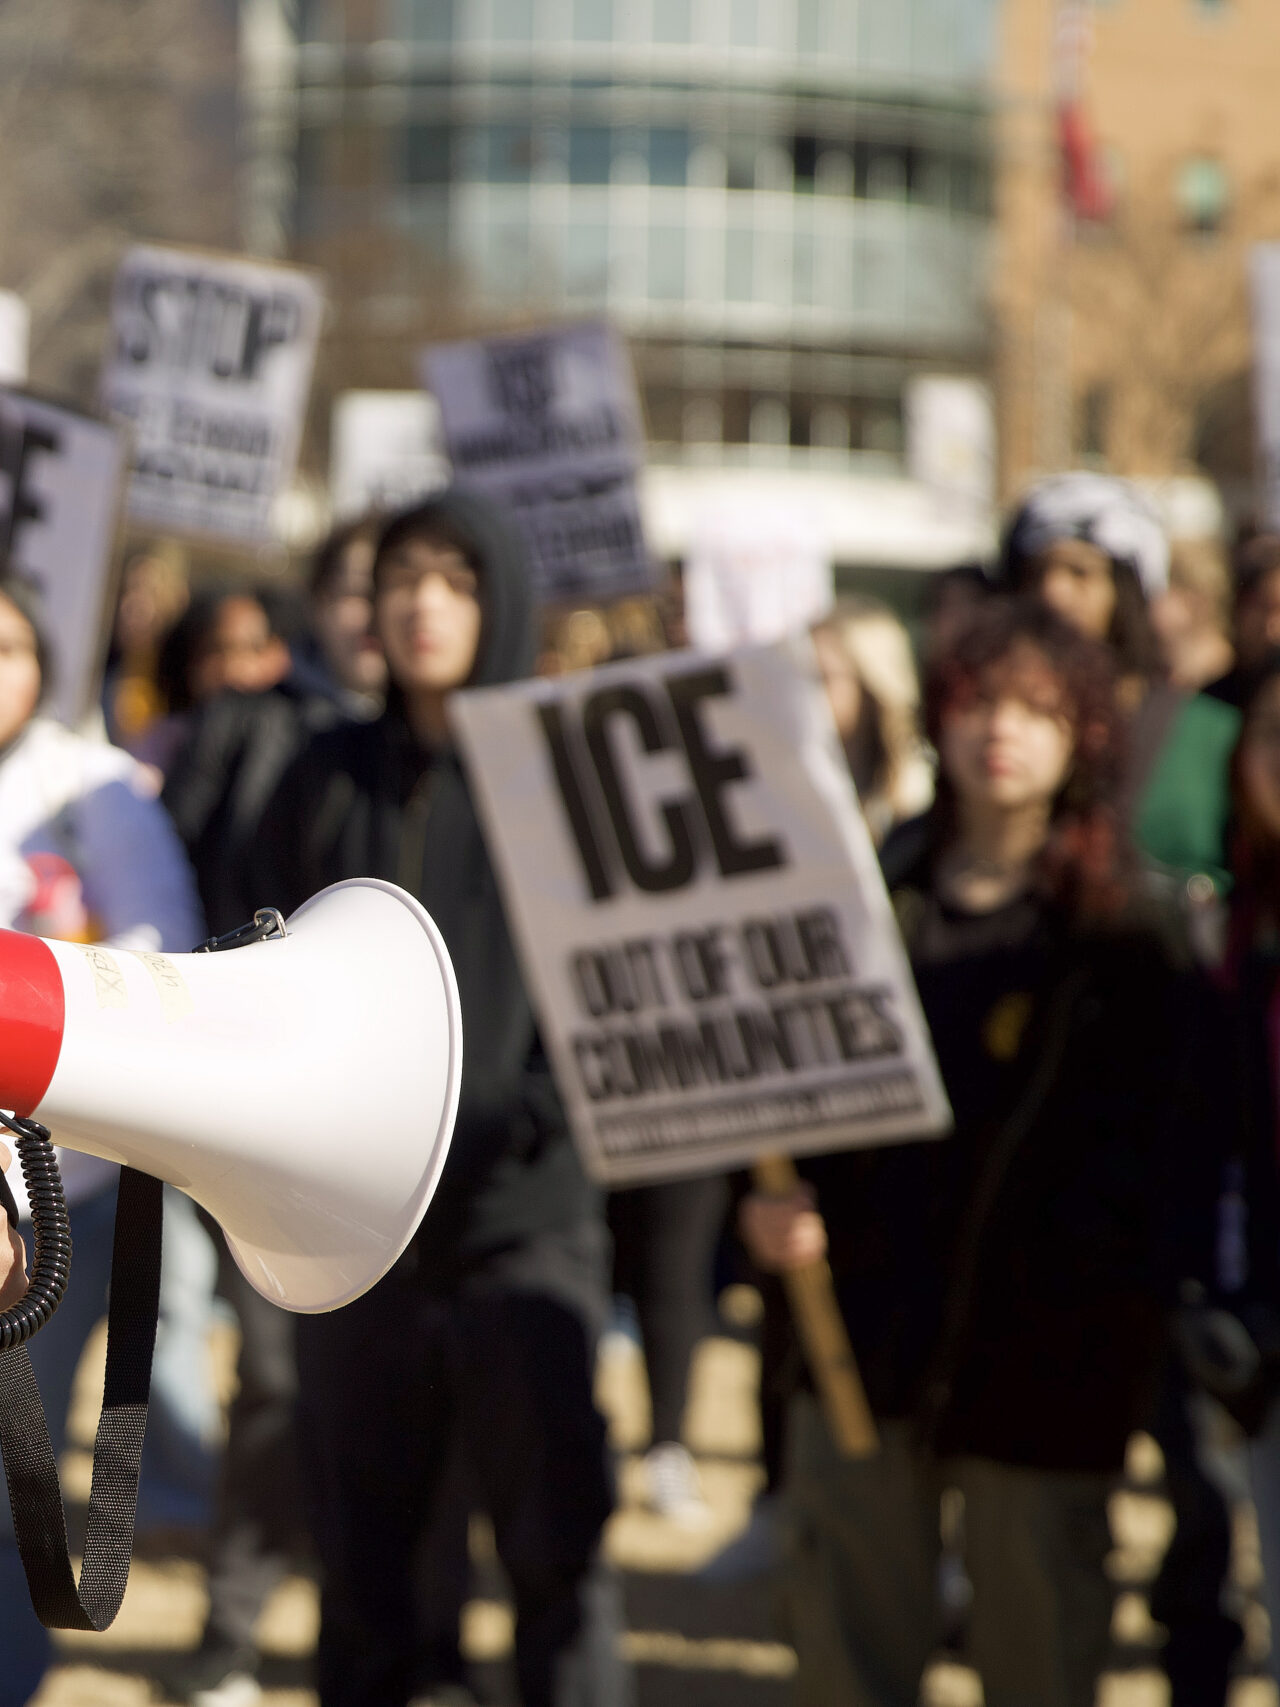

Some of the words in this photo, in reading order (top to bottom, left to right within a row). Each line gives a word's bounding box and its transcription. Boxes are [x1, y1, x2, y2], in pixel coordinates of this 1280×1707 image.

[117, 266, 302, 380] STOP
[531, 660, 791, 904] ICE
[571, 939, 666, 1020] OUT
[672, 927, 736, 1003] OF
[741, 911, 853, 989] OUR
[572, 982, 908, 1100] COMMUNITIES
